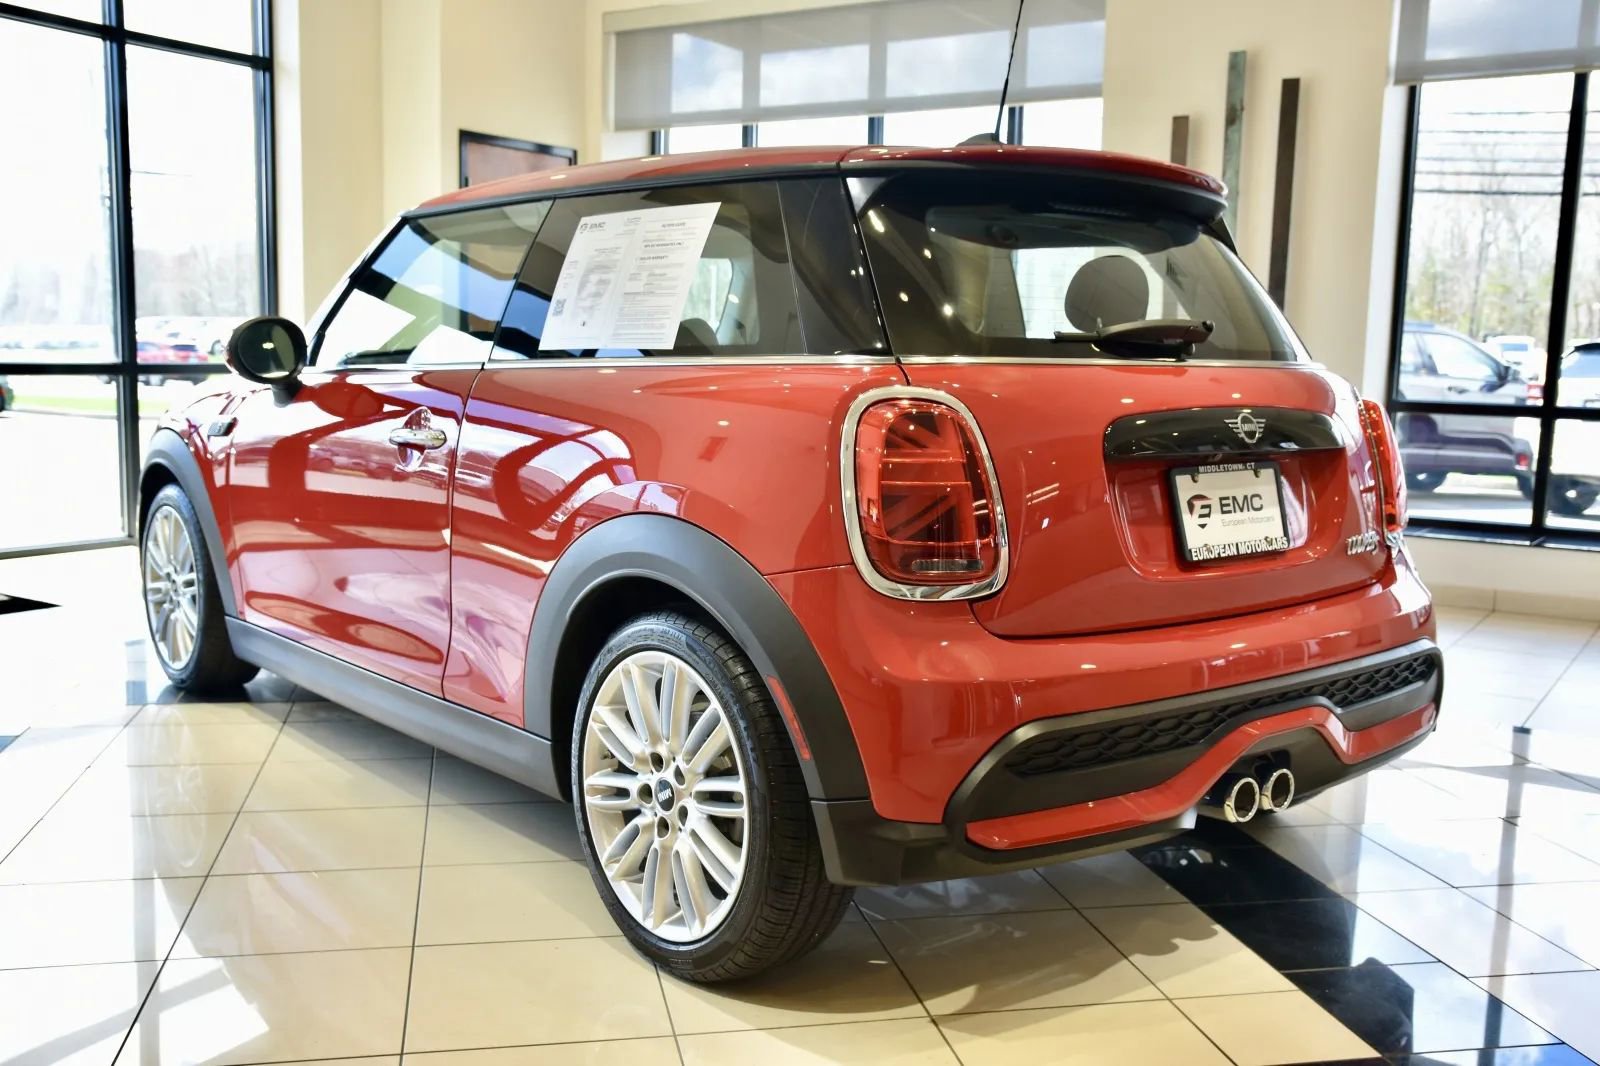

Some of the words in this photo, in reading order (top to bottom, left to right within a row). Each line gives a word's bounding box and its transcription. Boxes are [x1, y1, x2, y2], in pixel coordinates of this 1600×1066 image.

[1241, 423, 1258, 432] MINI
[1246, 462, 1255, 470] CT
[1218, 493, 1264, 515] EMC
[1191, 543, 1238, 561] EUROPEAN
[1238, 536, 1289, 552] MOTORCARS
[657, 787, 673, 803] MINI
